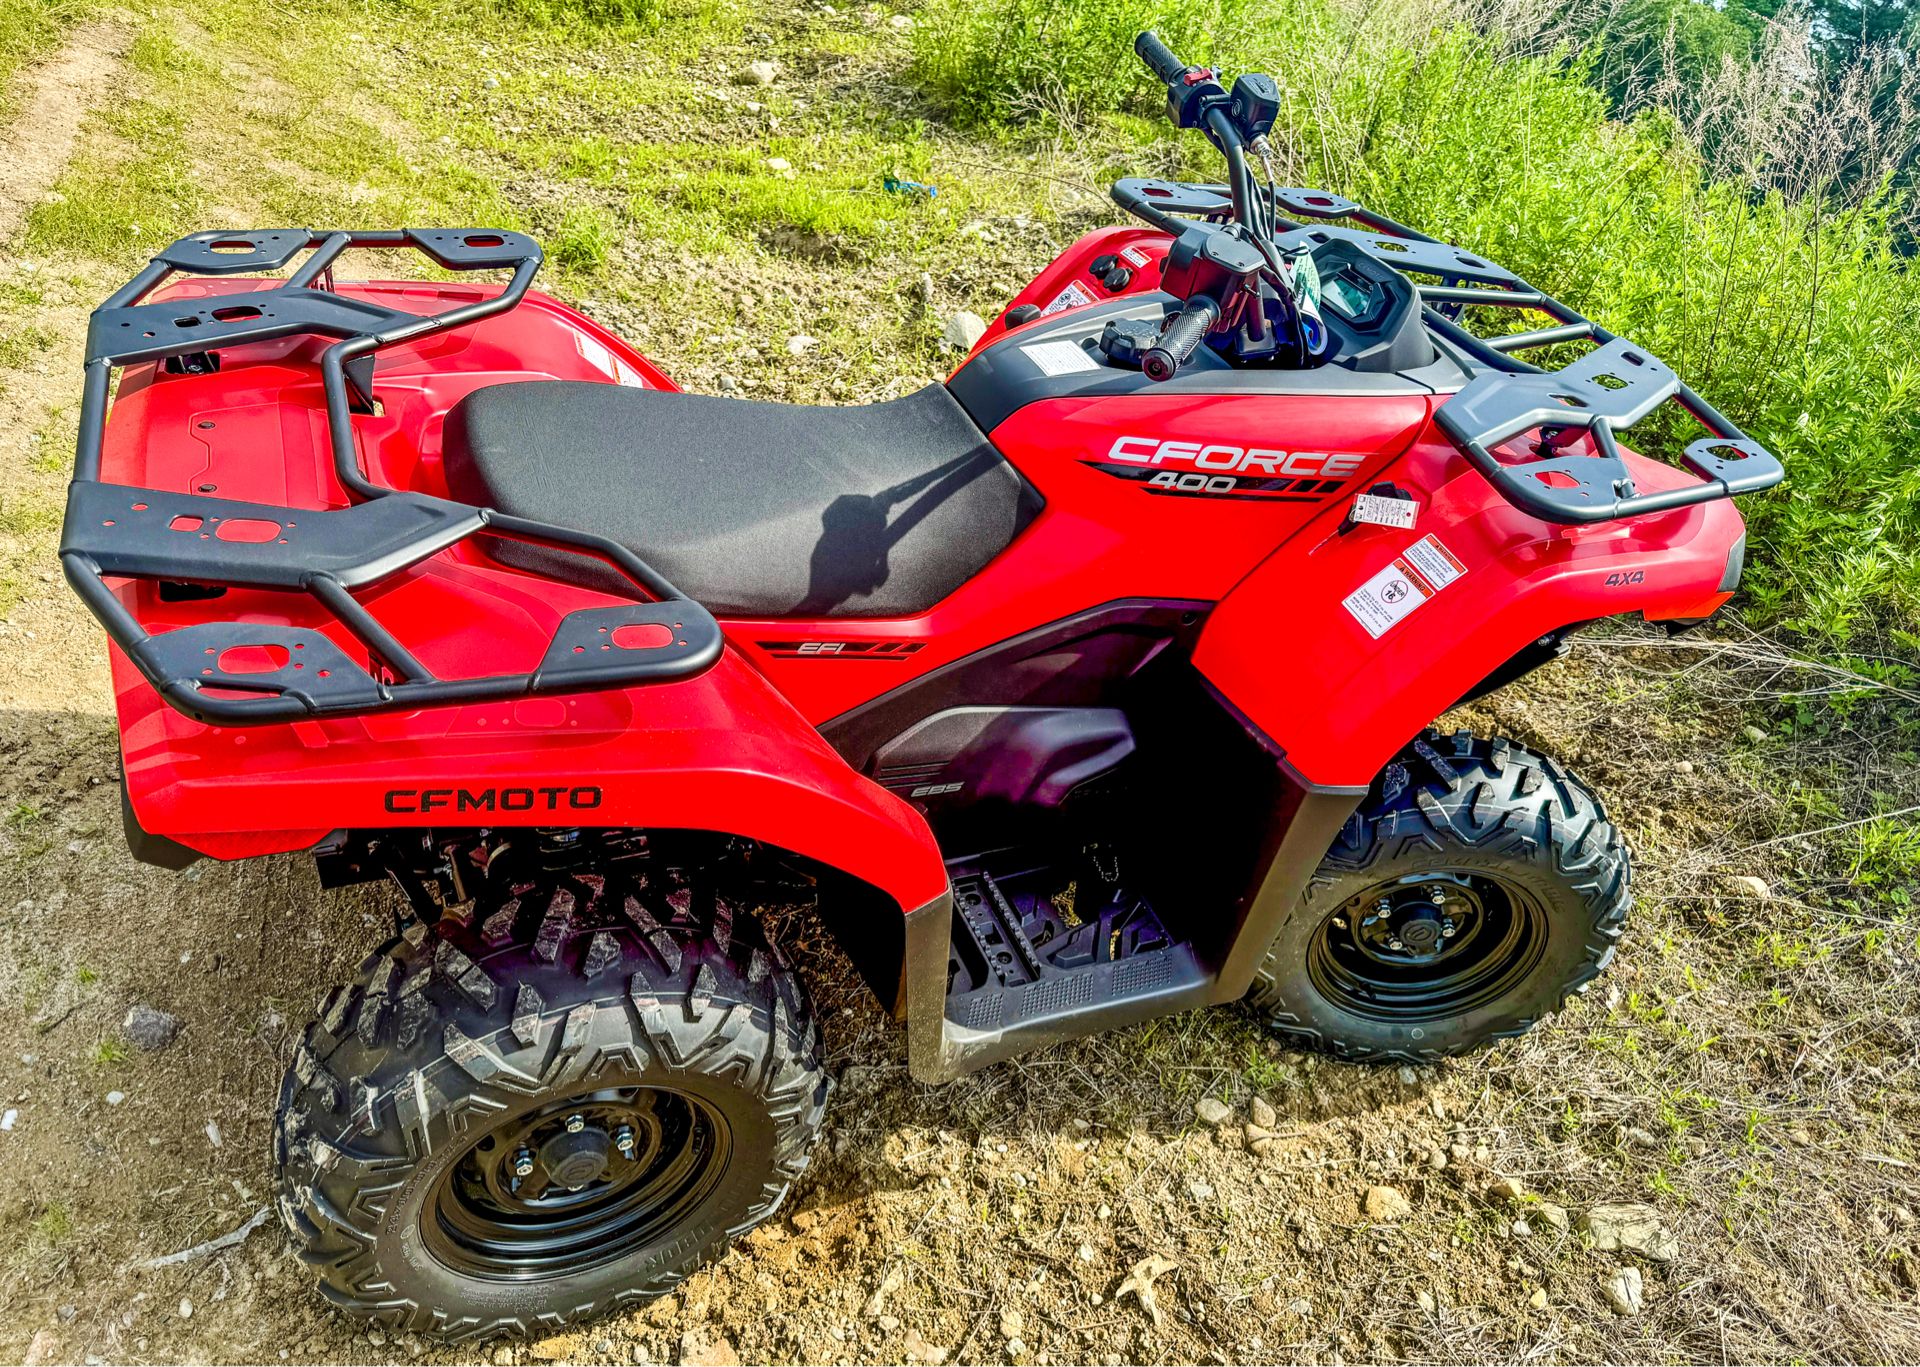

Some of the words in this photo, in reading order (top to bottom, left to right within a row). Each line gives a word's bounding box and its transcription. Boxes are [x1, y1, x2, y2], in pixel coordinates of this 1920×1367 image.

[1108, 436, 1366, 477] CFORCE
[1147, 471, 1237, 493] 400
[1404, 568, 1426, 592] WARNING
[1605, 570, 1644, 587] 4X4
[796, 641, 846, 655] EFI
[384, 786, 603, 813] CFMOTO
